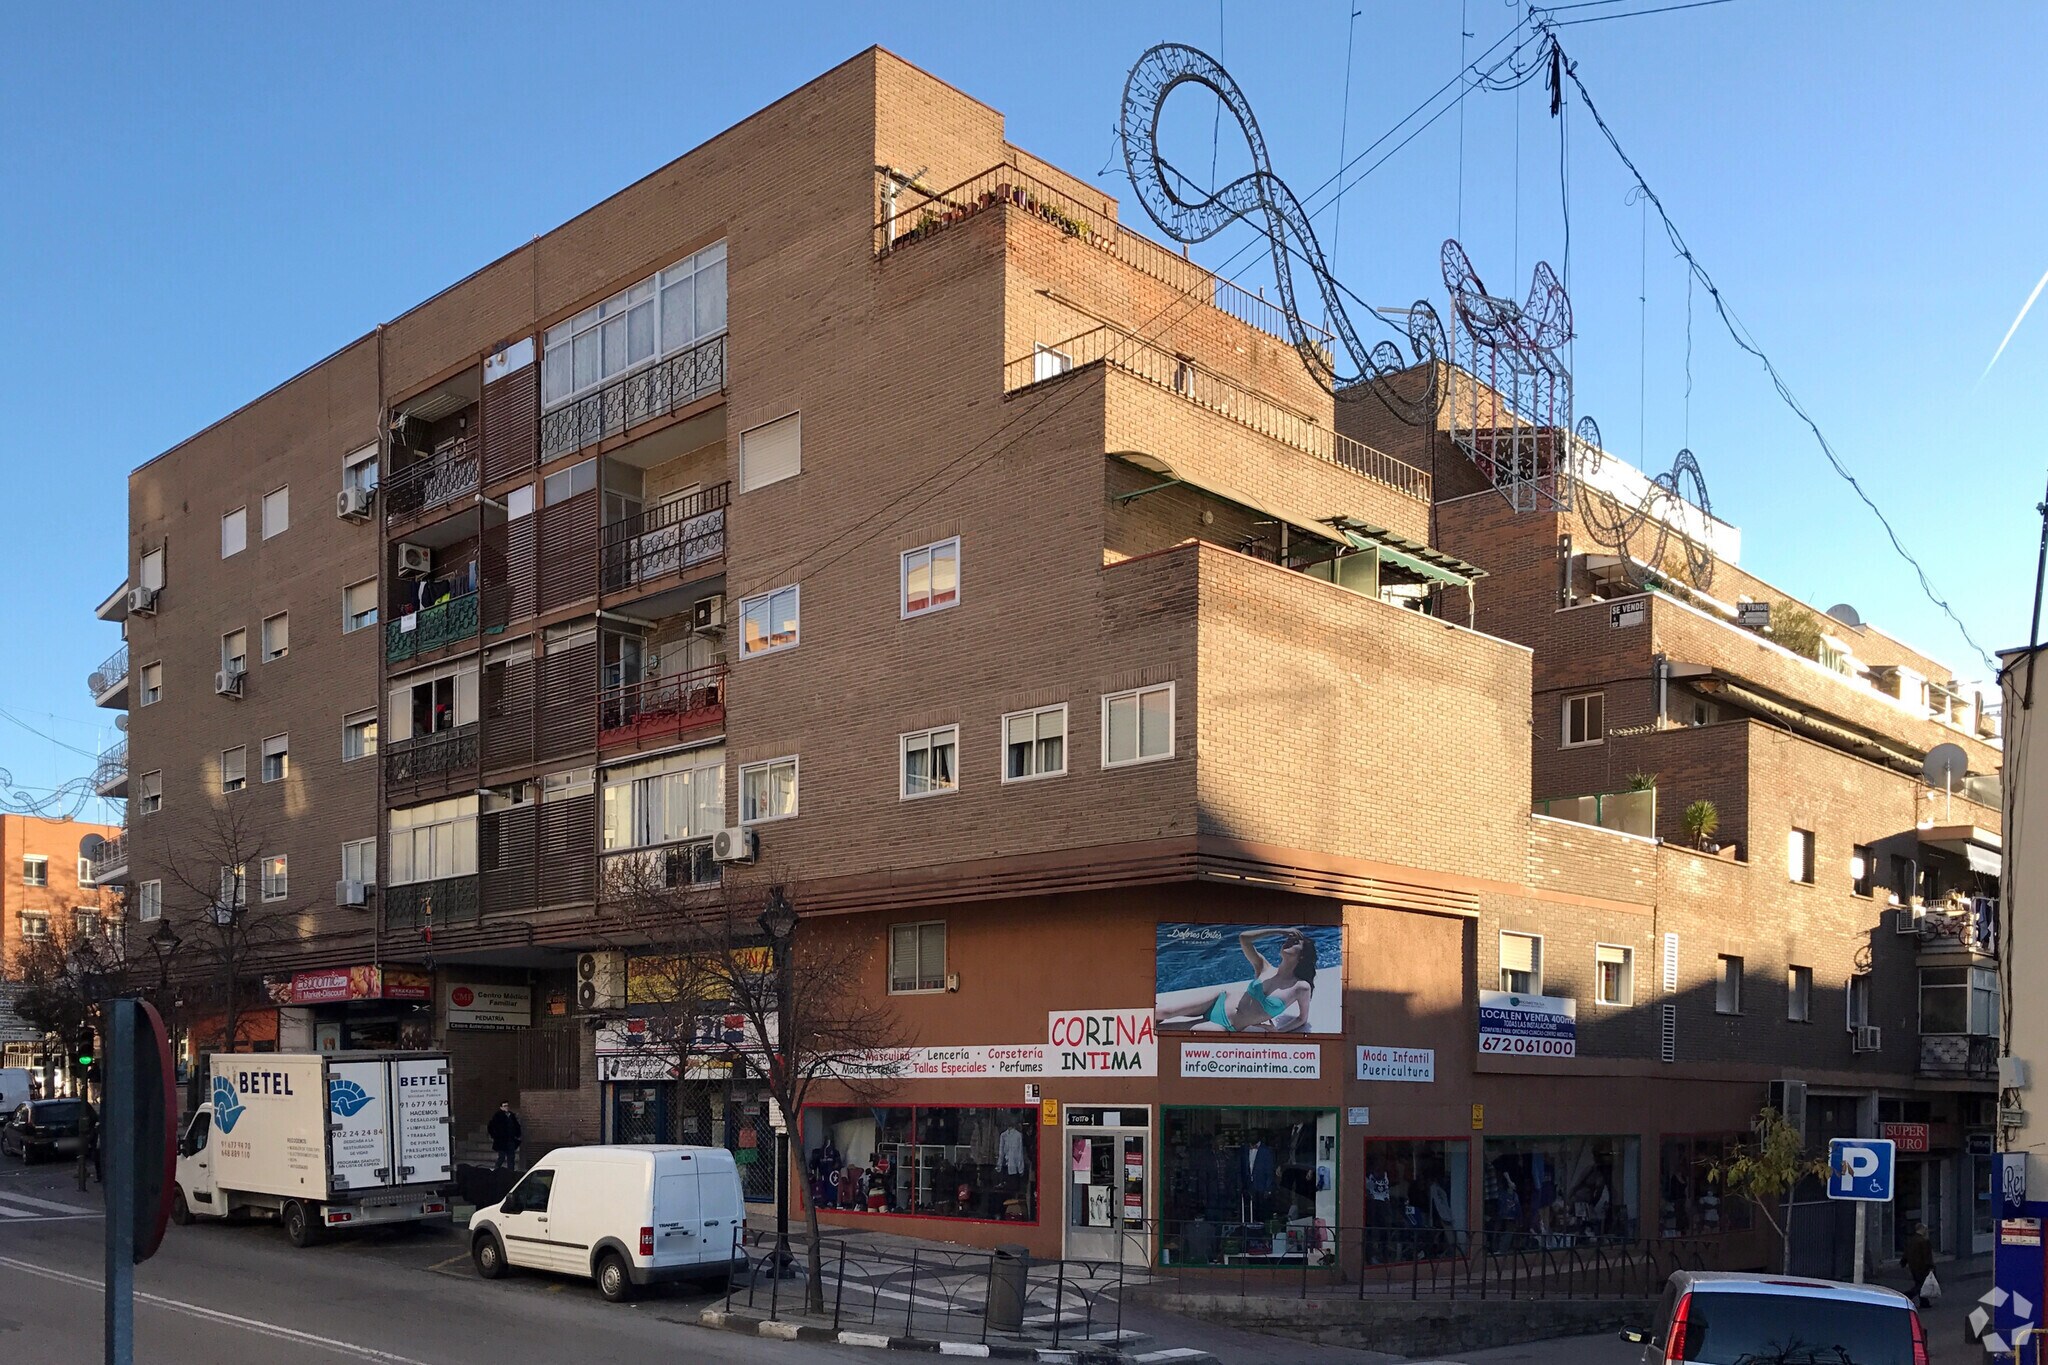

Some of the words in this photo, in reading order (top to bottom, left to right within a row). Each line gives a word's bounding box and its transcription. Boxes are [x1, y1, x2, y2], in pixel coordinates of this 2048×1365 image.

[1612, 606, 1621, 614] SE
[1622, 602, 1644, 613] VENDE
[1167, 928, 1200, 940] Dolores
[1481, 1010, 1509, 1020] LOCAL
[1510, 1011, 1522, 1020] EN
[1524, 1012, 1550, 1022] VENTA
[1052, 1015, 1154, 1047] CORINA
[1527, 1022, 1557, 1030] INSTALACIONES
[928, 1048, 970, 1060] Lencería
[988, 1046, 1043, 1059] Corsetería
[1185, 1048, 1316, 1060] www.corinaintima.com
[1362, 1050, 1387, 1062] Moda
[1393, 1051, 1429, 1064] Infantil
[842, 1065, 863, 1074] Moda
[913, 1062, 938, 1073] Tallas
[942, 1061, 987, 1076] Especiales
[1000, 1060, 1042, 1073] Perfumes
[1061, 1052, 1142, 1070] INTIMA
[1185, 1060, 1316, 1074] info@corinaintima.com
[1362, 1063, 1429, 1078] Puericultura
[240, 1072, 294, 1096] BETEL
[400, 1076, 446, 1086] BETEL
[1886, 1125, 1925, 1137] SUPER
[1841, 1147, 1879, 1192] P
